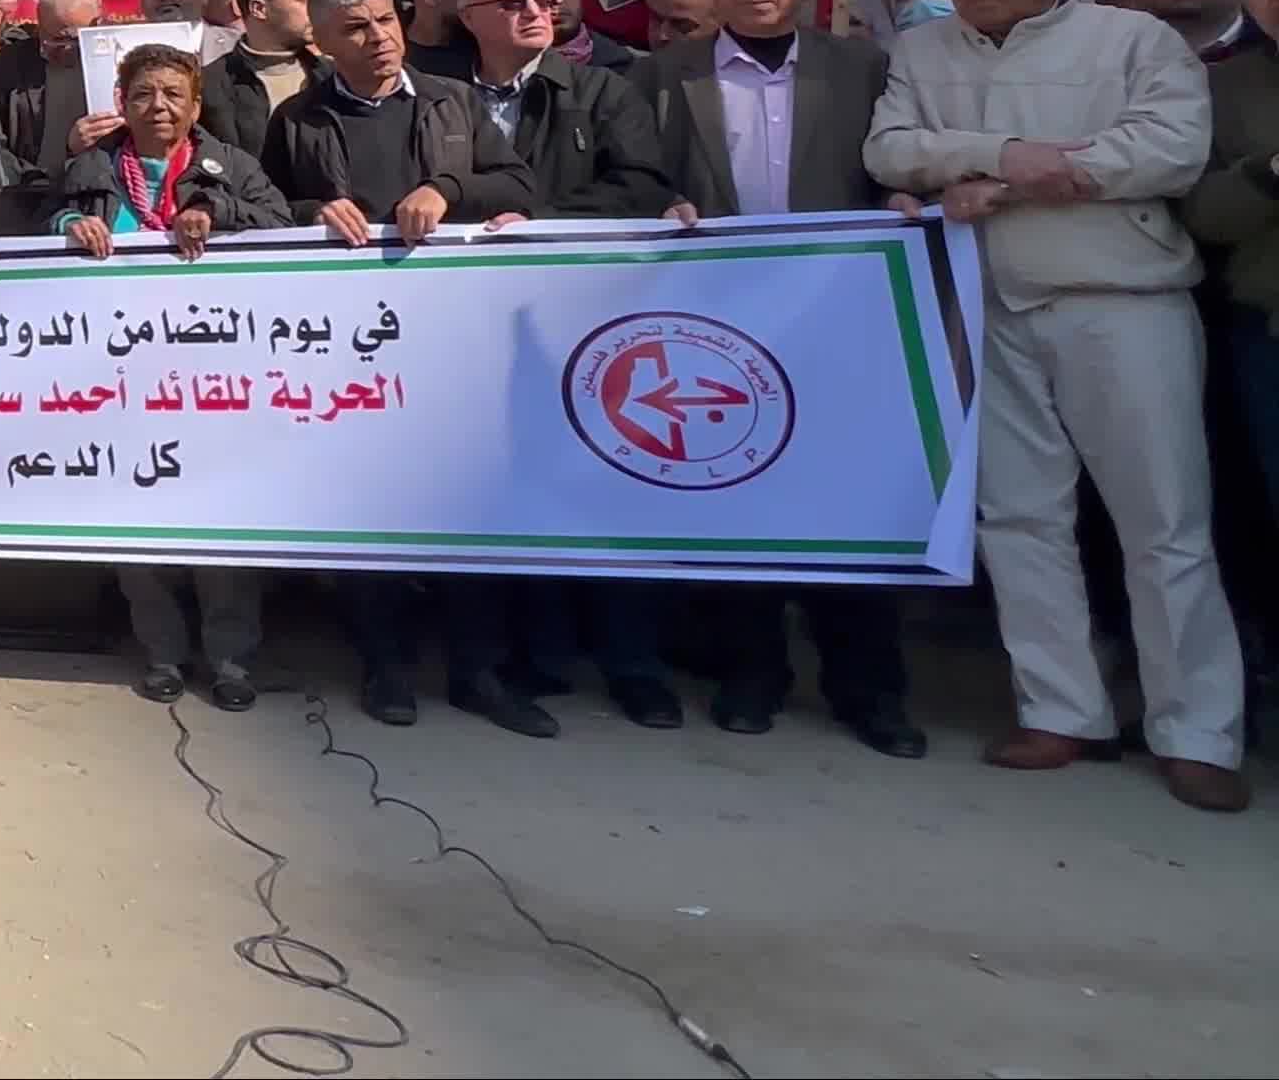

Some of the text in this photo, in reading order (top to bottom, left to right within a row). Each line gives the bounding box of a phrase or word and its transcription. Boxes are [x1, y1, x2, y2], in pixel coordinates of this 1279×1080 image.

[106, 303, 255, 357] التضامن
[270, 314, 332, 355] يوم
[352, 300, 401, 362] في
[38, 366, 127, 414] أحمد
[144, 369, 253, 412] للقائد
[265, 370, 405, 424] الحرية
[7, 441, 115, 489] الدعم
[132, 439, 182, 488] كل
